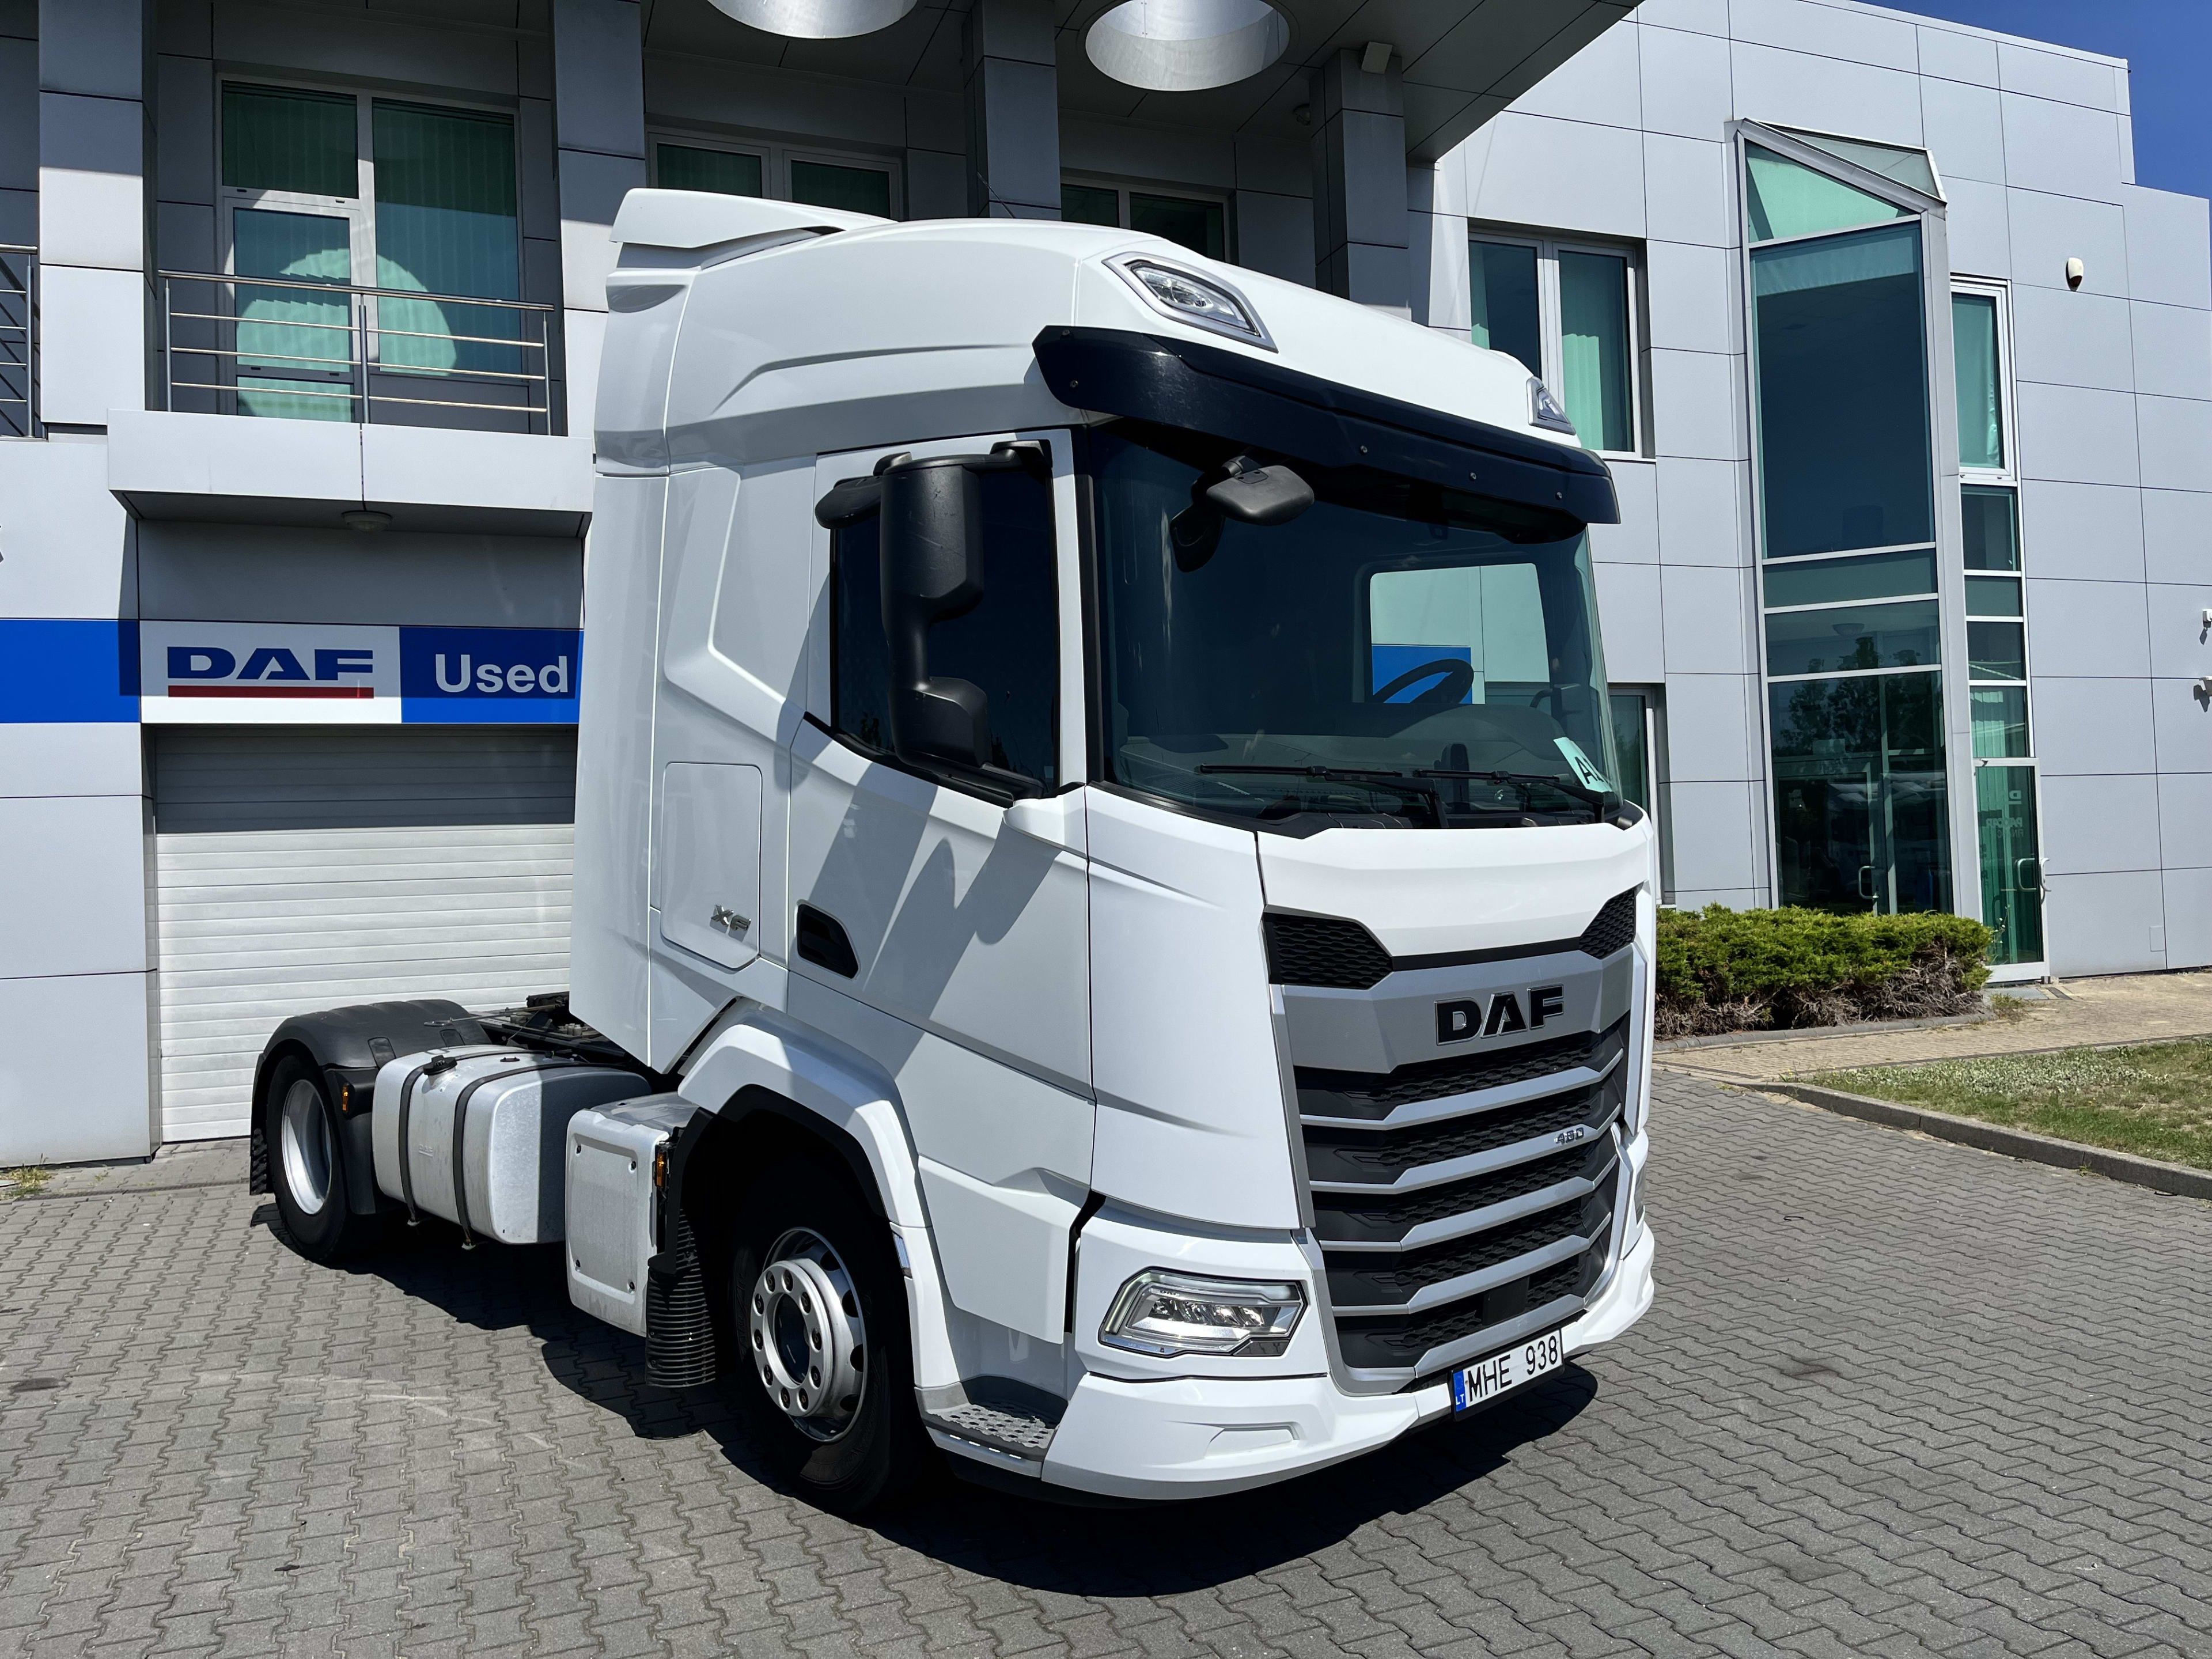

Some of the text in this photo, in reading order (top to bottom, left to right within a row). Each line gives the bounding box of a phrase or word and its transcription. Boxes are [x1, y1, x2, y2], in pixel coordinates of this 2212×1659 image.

[166, 646, 374, 681] DAF
[434, 654, 569, 694] Used
[1434, 984, 1564, 1046] DAF
[1467, 1335, 1558, 1402] MHE 938
[1455, 1393, 1465, 1406] LT
